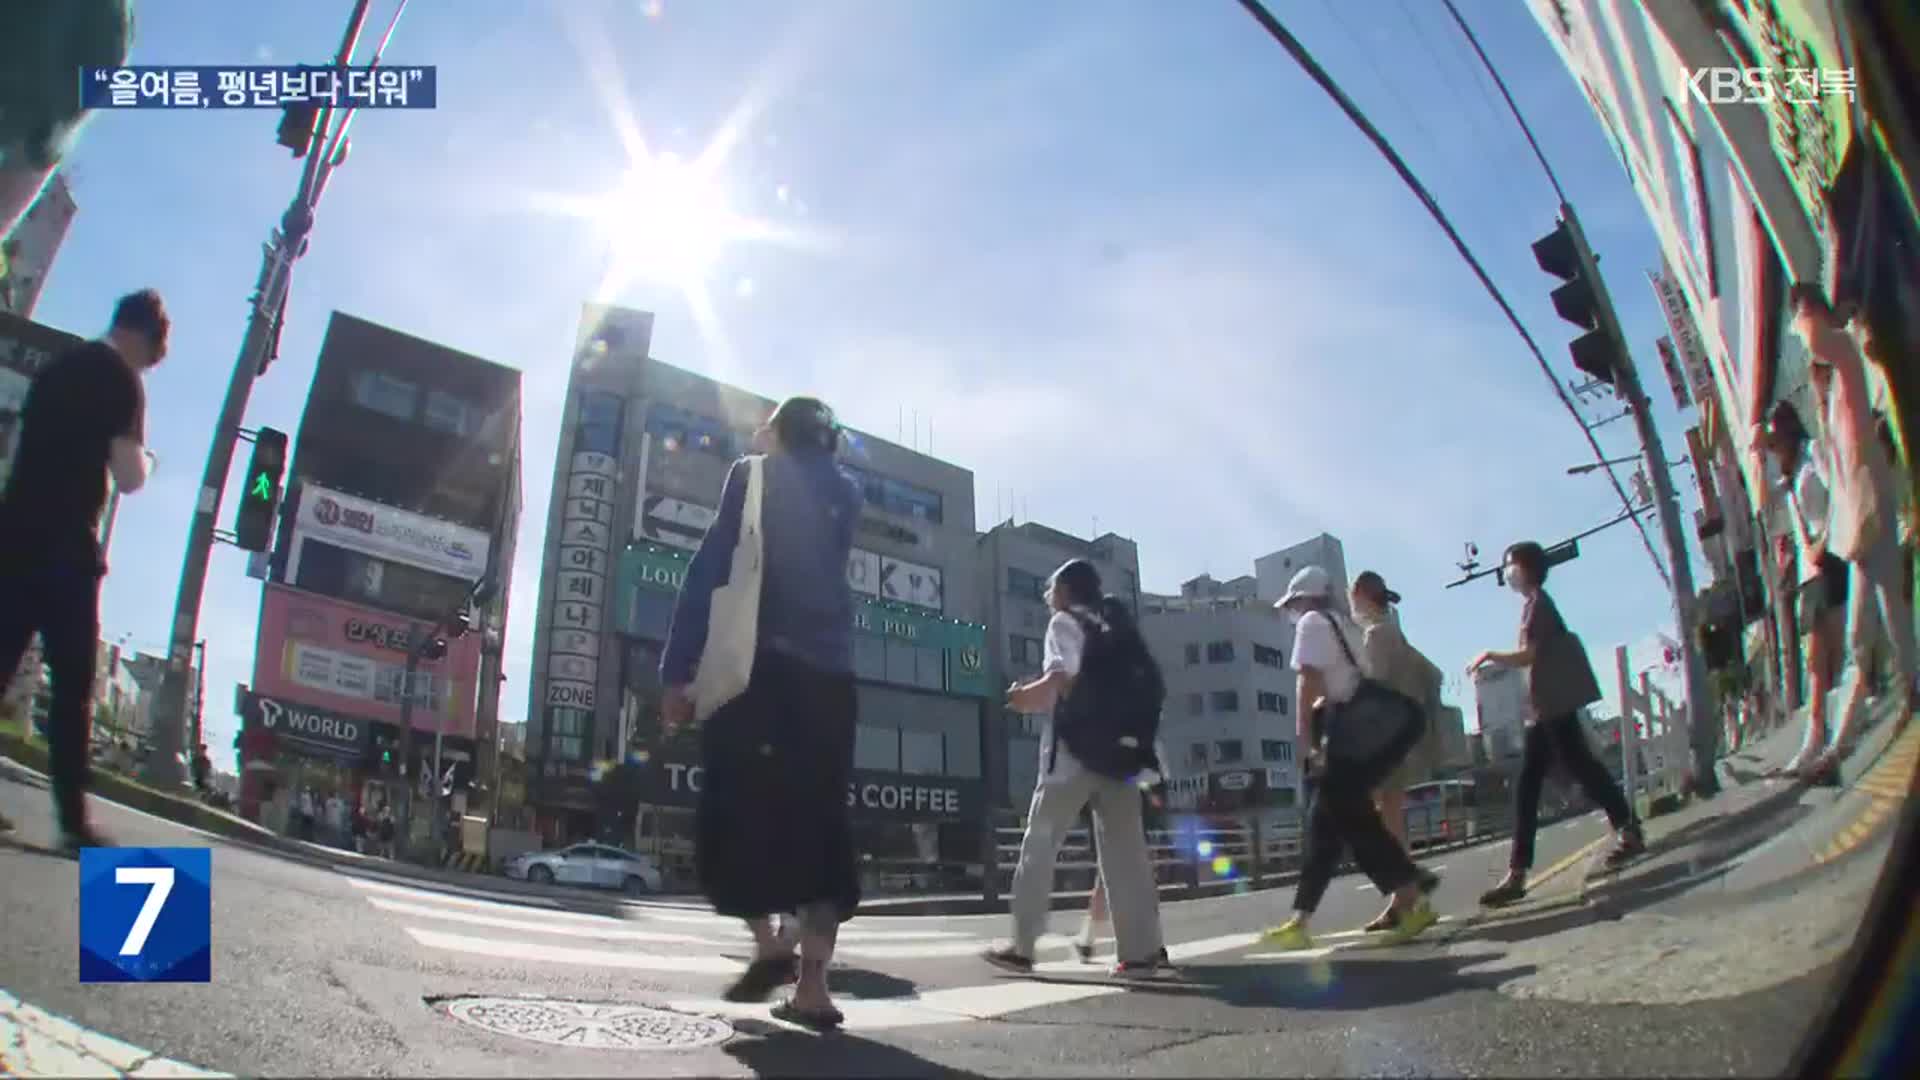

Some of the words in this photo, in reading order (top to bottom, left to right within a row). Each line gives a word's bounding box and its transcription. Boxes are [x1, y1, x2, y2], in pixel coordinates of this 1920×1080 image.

[551, 686, 593, 707] ZONE
[288, 709, 358, 741] WORLD
[861, 783, 960, 812] COFFEE
